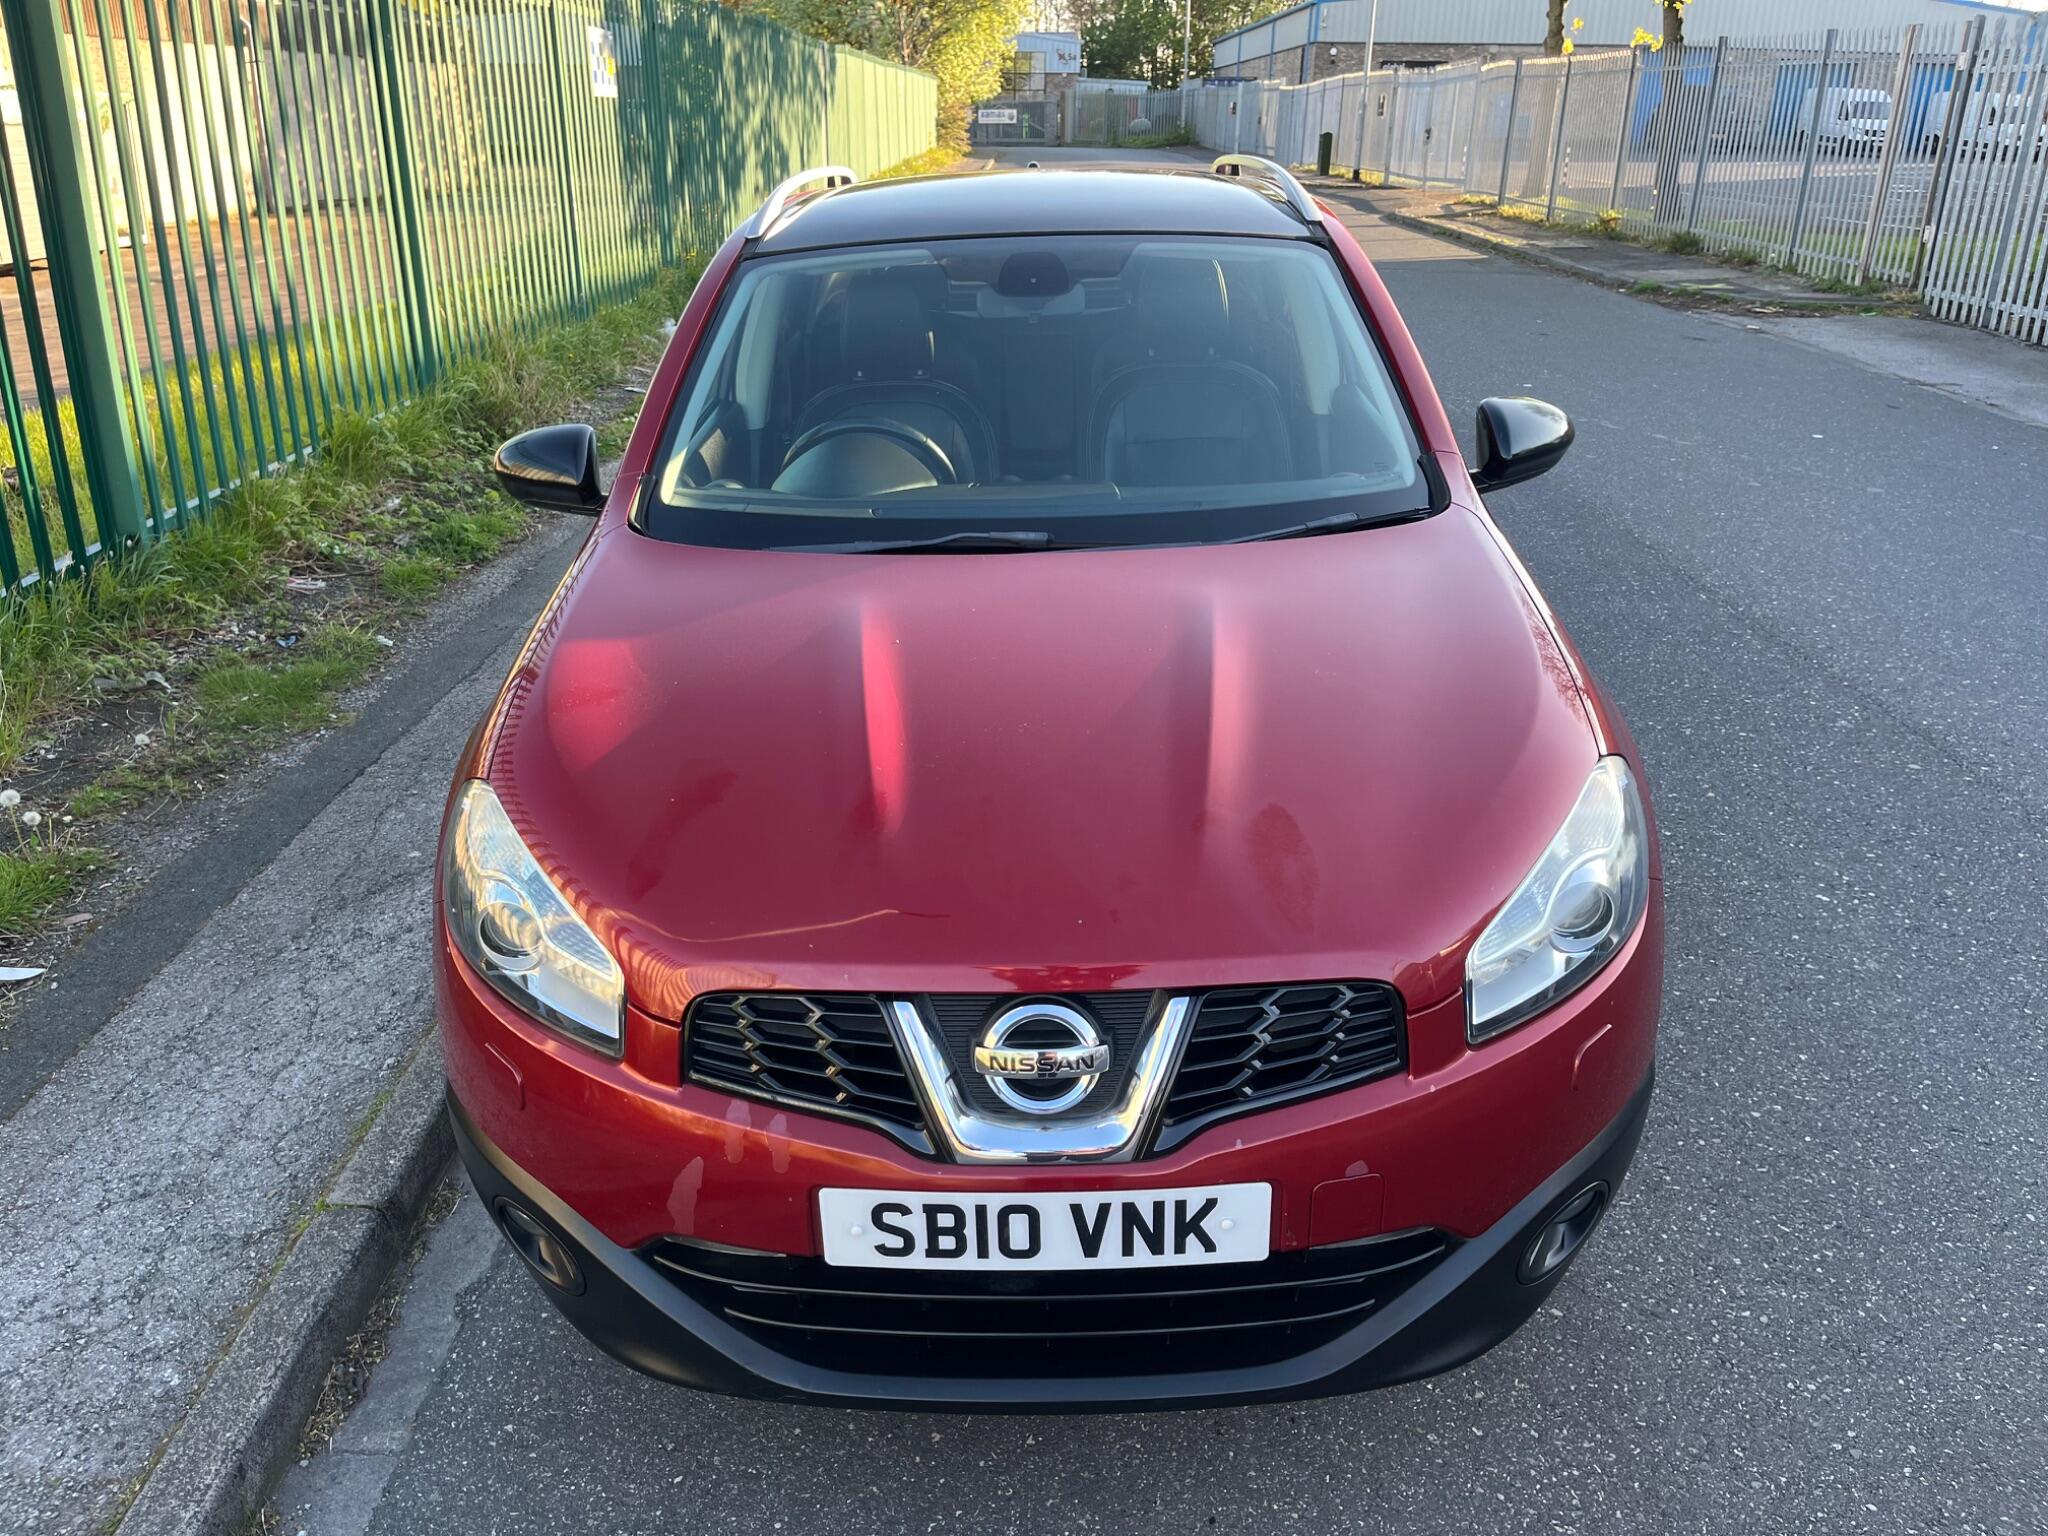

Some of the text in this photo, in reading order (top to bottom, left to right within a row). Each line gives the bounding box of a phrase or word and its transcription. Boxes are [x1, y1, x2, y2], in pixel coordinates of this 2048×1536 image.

[989, 1053, 1094, 1073] NISSAN
[871, 1197, 1219, 1259] SB10 VNK
